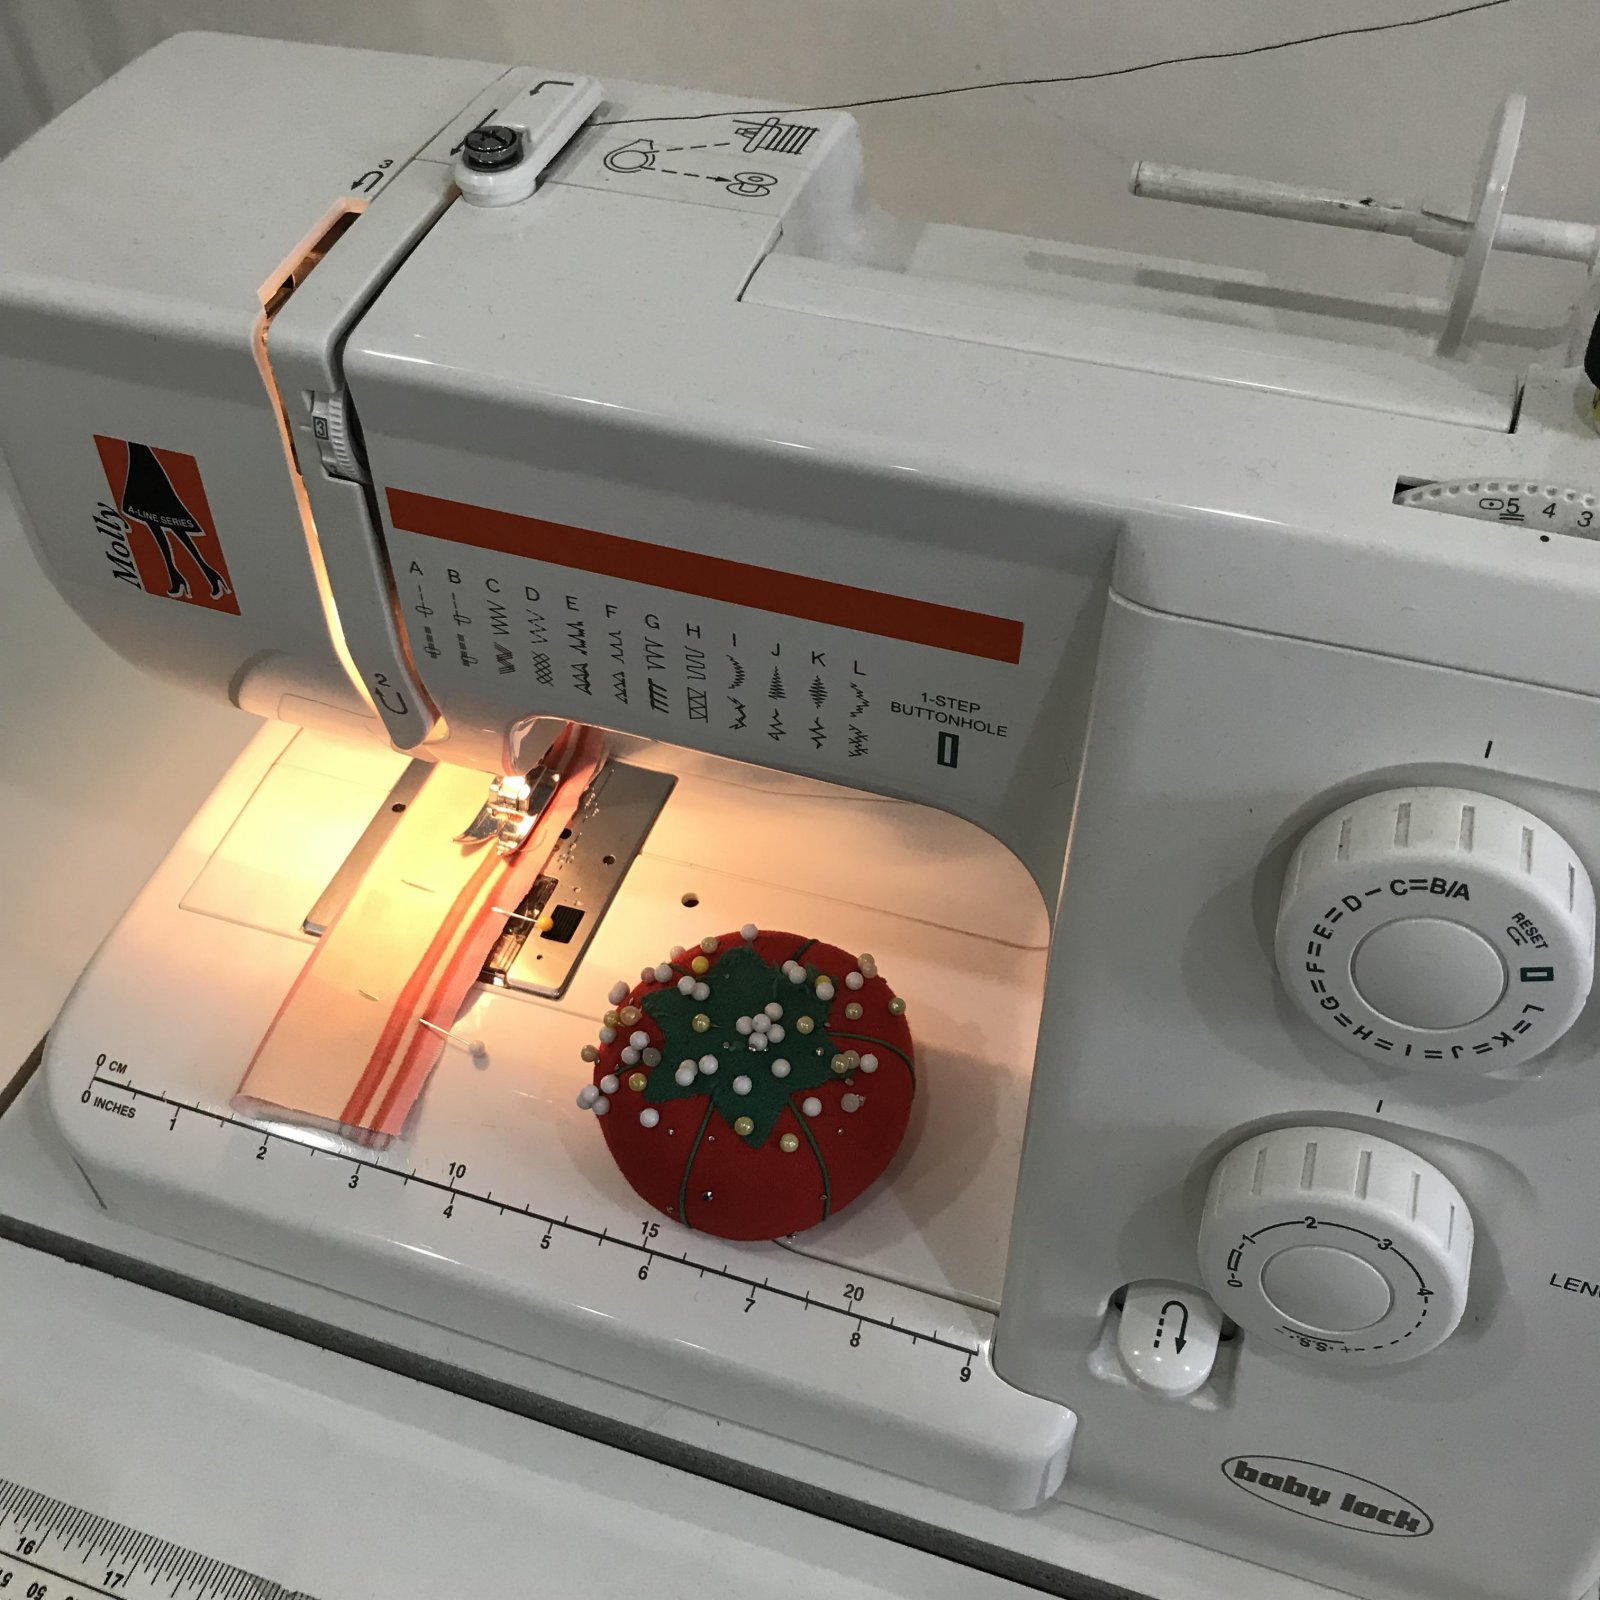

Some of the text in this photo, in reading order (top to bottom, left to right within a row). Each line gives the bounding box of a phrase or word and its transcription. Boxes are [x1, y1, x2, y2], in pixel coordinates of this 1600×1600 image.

[379, 159, 393, 169] 3
[316, 418, 325, 437] 3
[128, 505, 194, 529] A-LINE SERIES
[1505, 498, 1594, 527] 5 4 3
[93, 502, 142, 590] Molly
[409, 561, 423, 576] A
[447, 569, 462, 584] B
[486, 578, 500, 593] C
[525, 586, 540, 602] D
[566, 595, 578, 611] E
[605, 604, 618, 618] F
[645, 614, 660, 630] G
[686, 623, 701, 639] H
[771, 643, 780, 657] J
[811, 651, 826, 667] K
[853, 660, 866, 676] L
[374, 673, 391, 688] 2
[921, 692, 981, 714] 1-STEP
[890, 701, 1008, 738] BUTTONHOLE
[1342, 894, 1363, 912] D
[1313, 923, 1333, 940] E
[1511, 912, 1549, 950] RESET
[1306, 961, 1325, 973] F
[1320, 996, 1340, 1011] G
[1522, 1003, 1545, 1014] L
[1352, 1025, 1374, 1041] H
[1491, 1031, 1515, 1048] K
[96, 1053, 128, 1074] 0 CM
[81, 1090, 136, 1119] 0 INCHES
[168, 1118, 178, 1131] 1
[256, 1146, 267, 1160] 2
[448, 1161, 467, 1179] 10
[348, 1175, 360, 1189] 3
[442, 1204, 453, 1219] 4
[640, 1219, 661, 1239] 15
[1304, 1216, 1317, 1229] 2
[540, 1235, 552, 1250] 5
[1242, 1234, 1256, 1246] 1
[1377, 1238, 1393, 1251] 3
[637, 1265, 649, 1281] 6
[1227, 1279, 1243, 1288] 0
[1416, 1286, 1434, 1297] 4
[1550, 1272, 1600, 1298] LEN
[843, 1283, 865, 1302] 20
[743, 1298, 756, 1314] 7
[849, 1331, 861, 1348] 8
[959, 1366, 972, 1383] 9
[1233, 1460, 1421, 1533] baby lock
[16, 1537, 36, 1555] 16
[103, 1570, 124, 1589] 17
